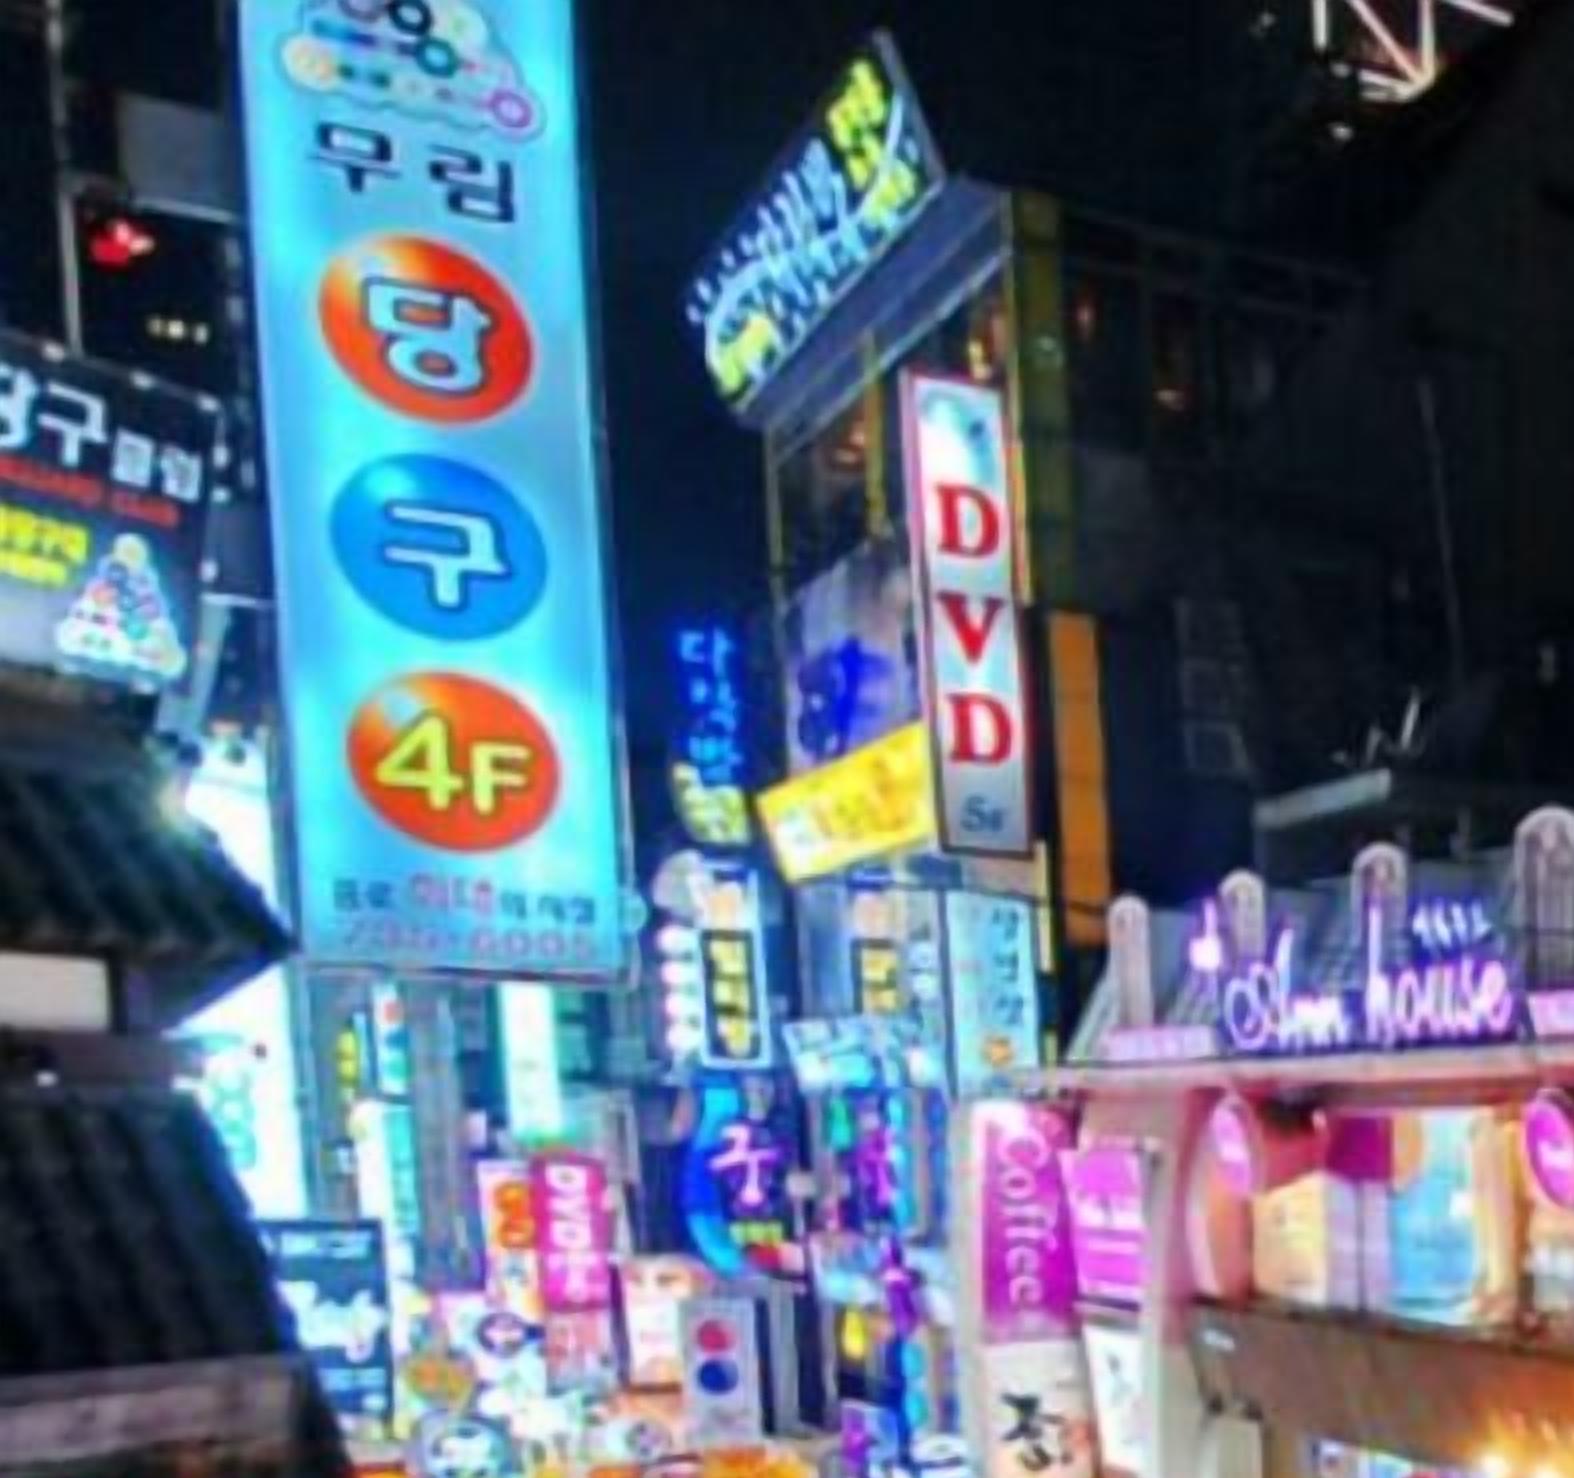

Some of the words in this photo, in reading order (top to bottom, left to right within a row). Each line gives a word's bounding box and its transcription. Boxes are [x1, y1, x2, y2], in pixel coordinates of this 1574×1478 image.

[932, 484, 1013, 764] DVD
[374, 715, 534, 814] 4F
[1223, 926, 1347, 1049] Ann
[1367, 903, 1513, 1048] house
[998, 1126, 1060, 1306] Coffee
